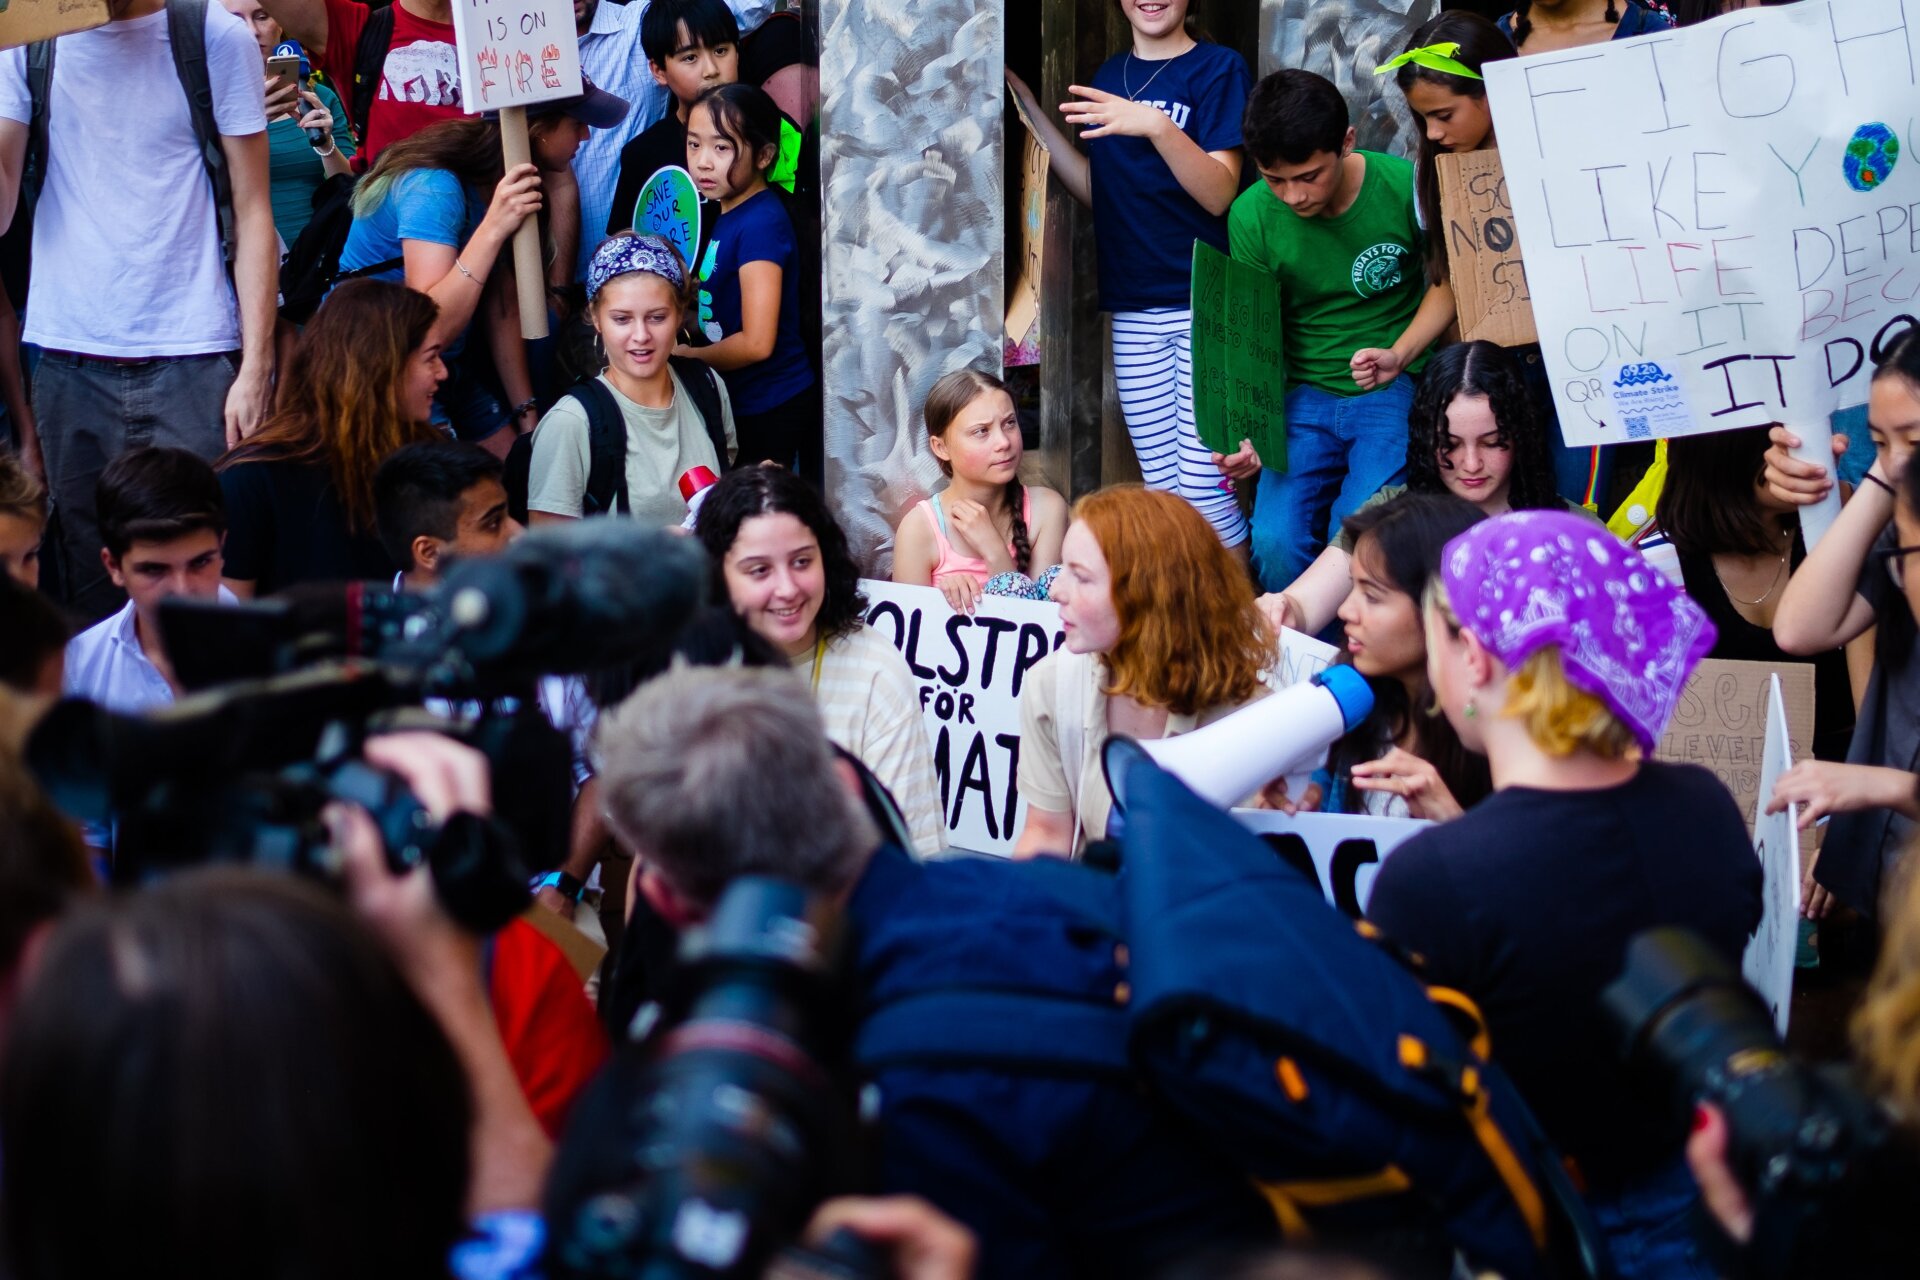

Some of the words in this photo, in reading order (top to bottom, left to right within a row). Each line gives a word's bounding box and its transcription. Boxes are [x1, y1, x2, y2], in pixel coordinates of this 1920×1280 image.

[488, 16, 508, 41] IS
[520, 11, 546, 35] ON
[477, 44, 562, 104] FIRE
[646, 180, 672, 215] SAVE
[652, 199, 681, 232] OUR
[1540, 152, 1729, 248] LIKE
[1353, 247, 1379, 282] FRIDAYS
[1381, 245, 1402, 256] FOR
[1580, 235, 1755, 313] LIFE
[1202, 258, 1223, 313] Yo
[1564, 321, 1647, 373] ON
[1676, 302, 1764, 357] IT
[1800, 267, 1920, 342] BEC
[1622, 364, 1657, 378] 09.20
[1702, 354, 1797, 418] IT
[1236, 378, 1281, 416] mucho
[1565, 378, 1605, 404] QR
[1613, 390, 1648, 399] Climate
[1650, 385, 1679, 395] Strike
